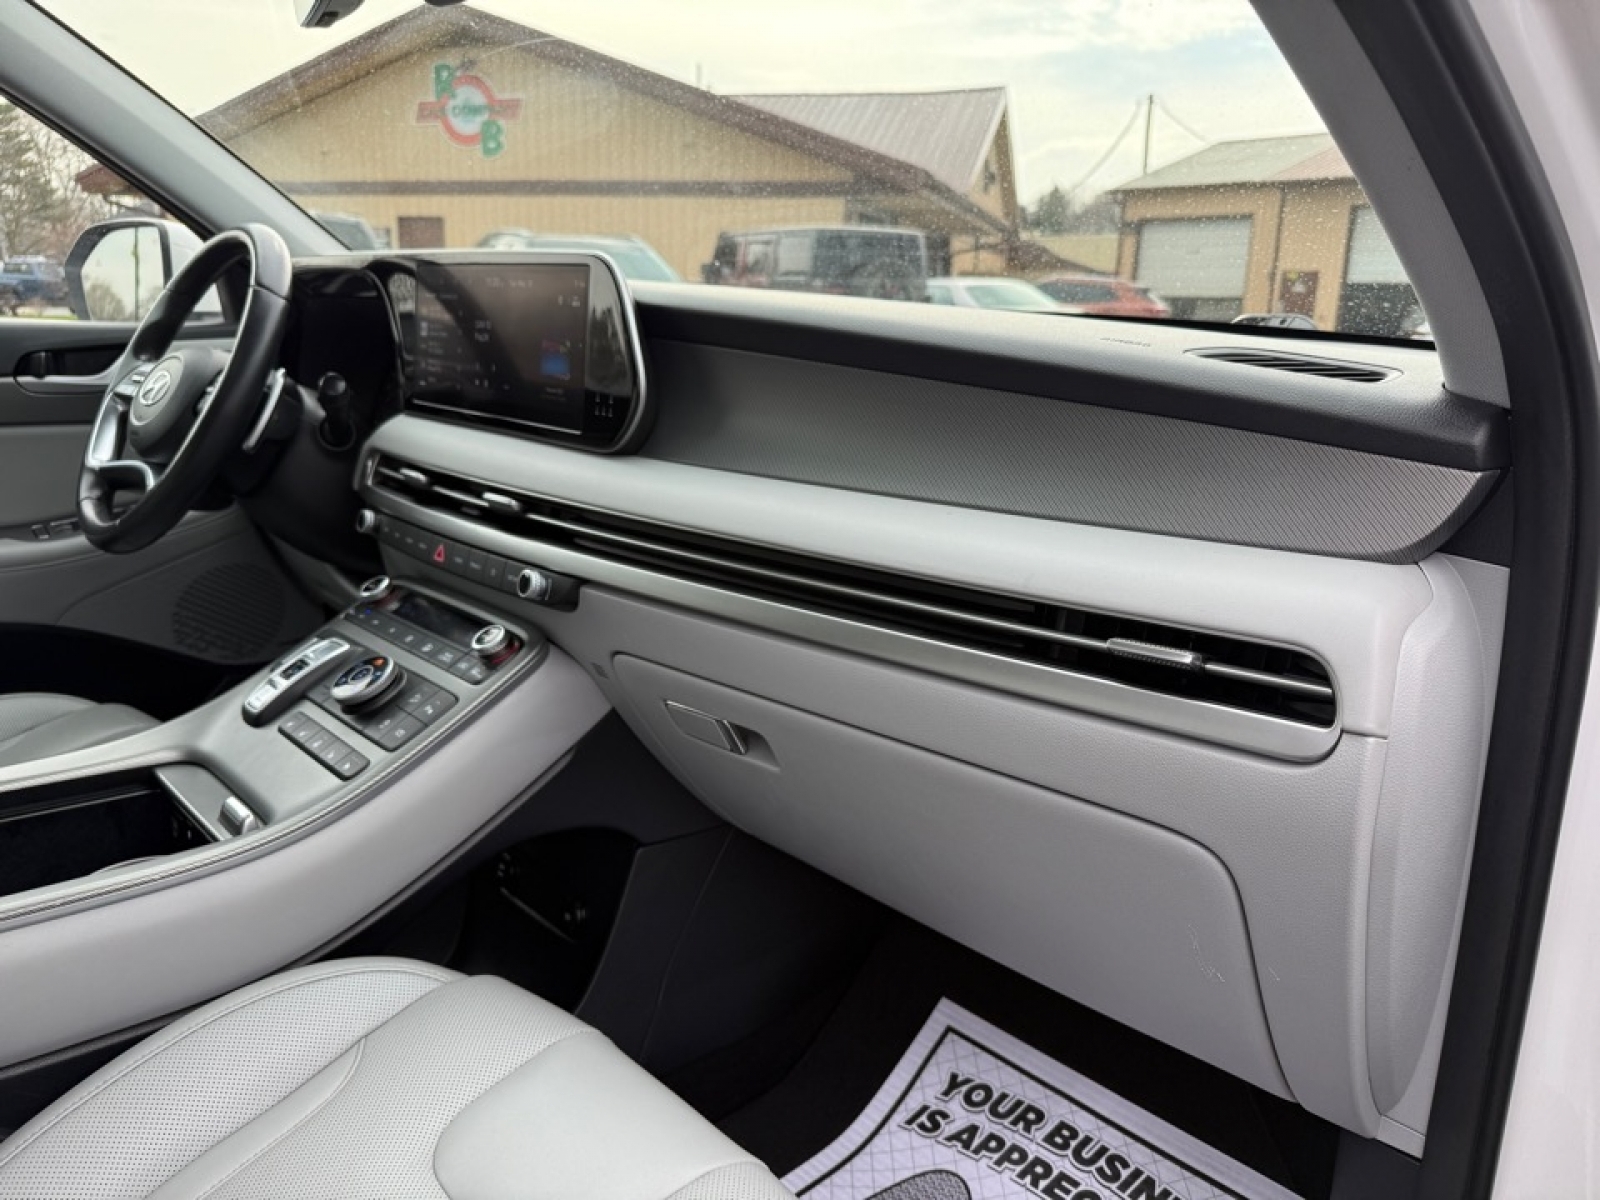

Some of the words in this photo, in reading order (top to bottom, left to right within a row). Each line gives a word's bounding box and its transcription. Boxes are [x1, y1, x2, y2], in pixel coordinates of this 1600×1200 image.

[481, 120, 504, 156] B
[904, 1104, 951, 1134] IS
[940, 1071, 1046, 1134] YOUR
[1041, 1119, 1182, 1200] BUSIN
